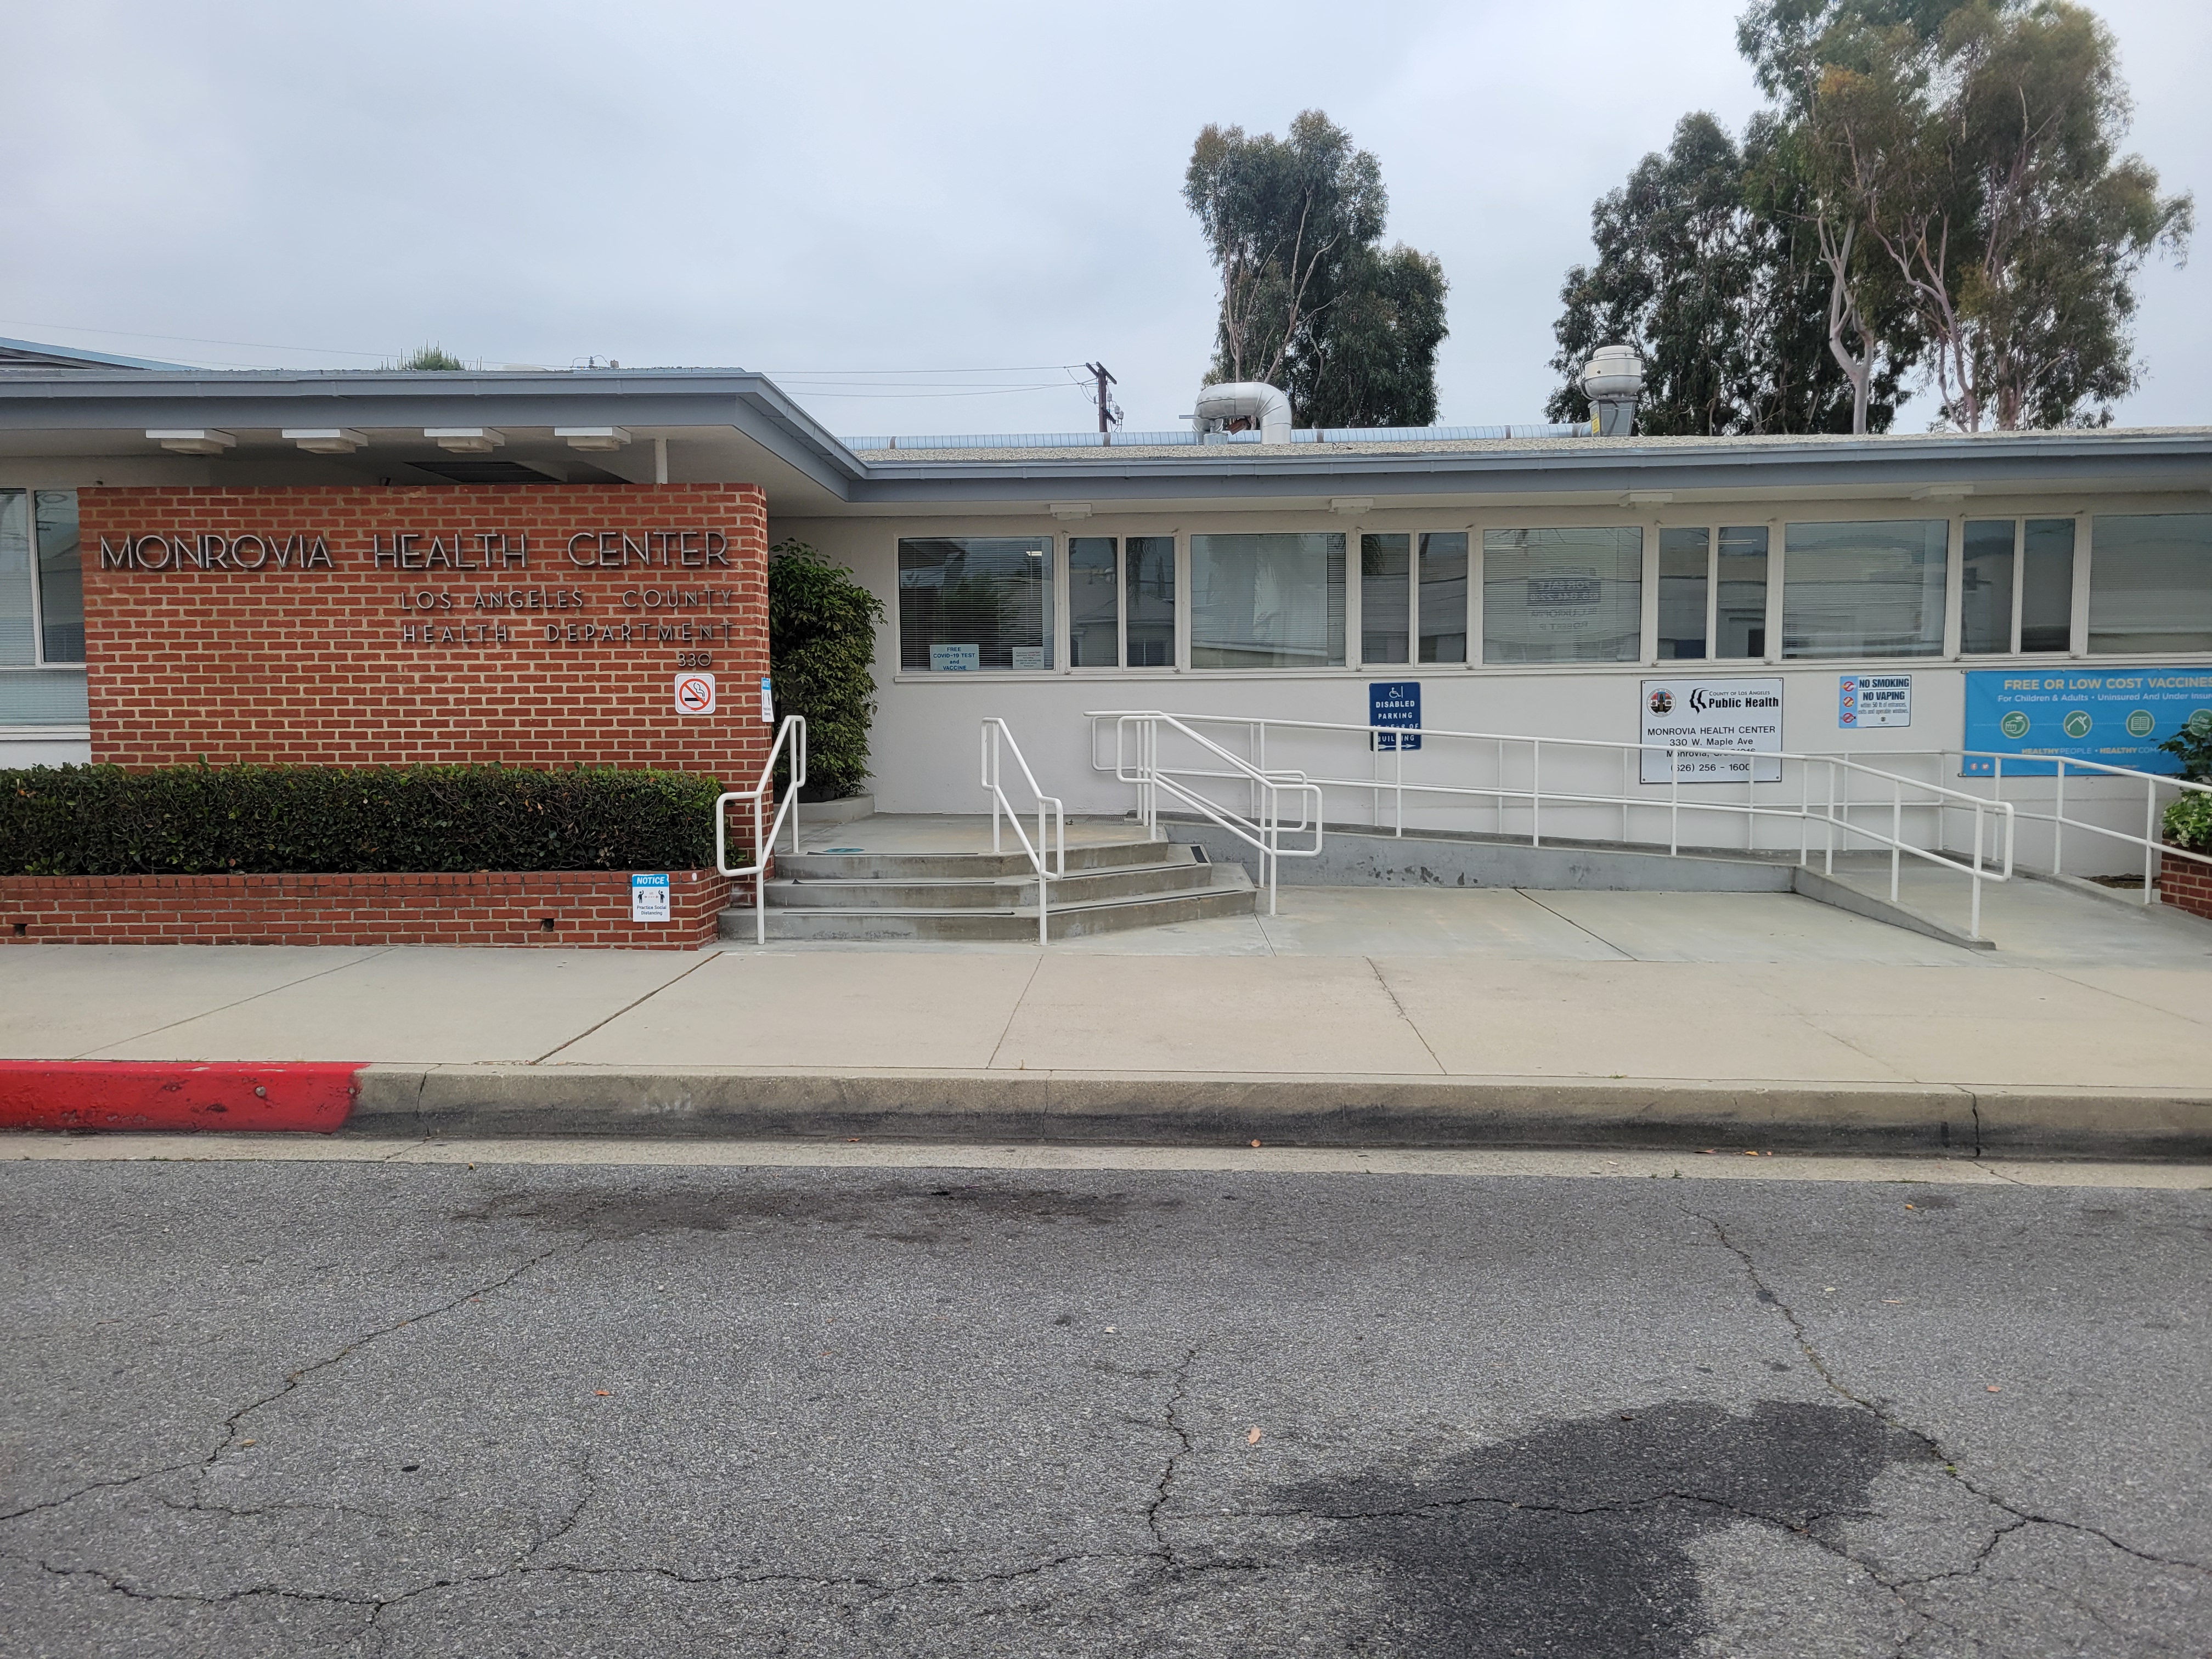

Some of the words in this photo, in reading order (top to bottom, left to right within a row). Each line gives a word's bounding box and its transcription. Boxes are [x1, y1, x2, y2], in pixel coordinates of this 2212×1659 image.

[101, 534, 335, 569] MONROVIA
[374, 533, 527, 568] HEALTH
[568, 531, 730, 566] CENTER
[401, 591, 452, 610] LOS
[473, 590, 583, 608] ANGELES
[622, 589, 732, 607] COUNTY
[403, 624, 508, 643] HEALTH
[546, 623, 733, 642] DEPARTMENT
[678, 653, 712, 667] 330
[1859, 679, 1870, 688] NO
[1872, 678, 1910, 687] SMOKING
[2004, 679, 2040, 690] FREE
[2044, 679, 2064, 690] OR
[2069, 678, 2102, 690] LOW
[2106, 678, 2143, 689] COST
[1863, 692, 1874, 701] NO
[1876, 691, 1905, 700] VAPING
[1708, 698, 1741, 708] Public
[1745, 697, 1779, 708] Health
[1647, 727, 1696, 736] MONROVIA
[1700, 726, 1735, 735] HEALTH
[1738, 725, 1776, 734] CENTER
[1707, 738, 1733, 747] Maple
[636, 876, 665, 884] NOTICE
